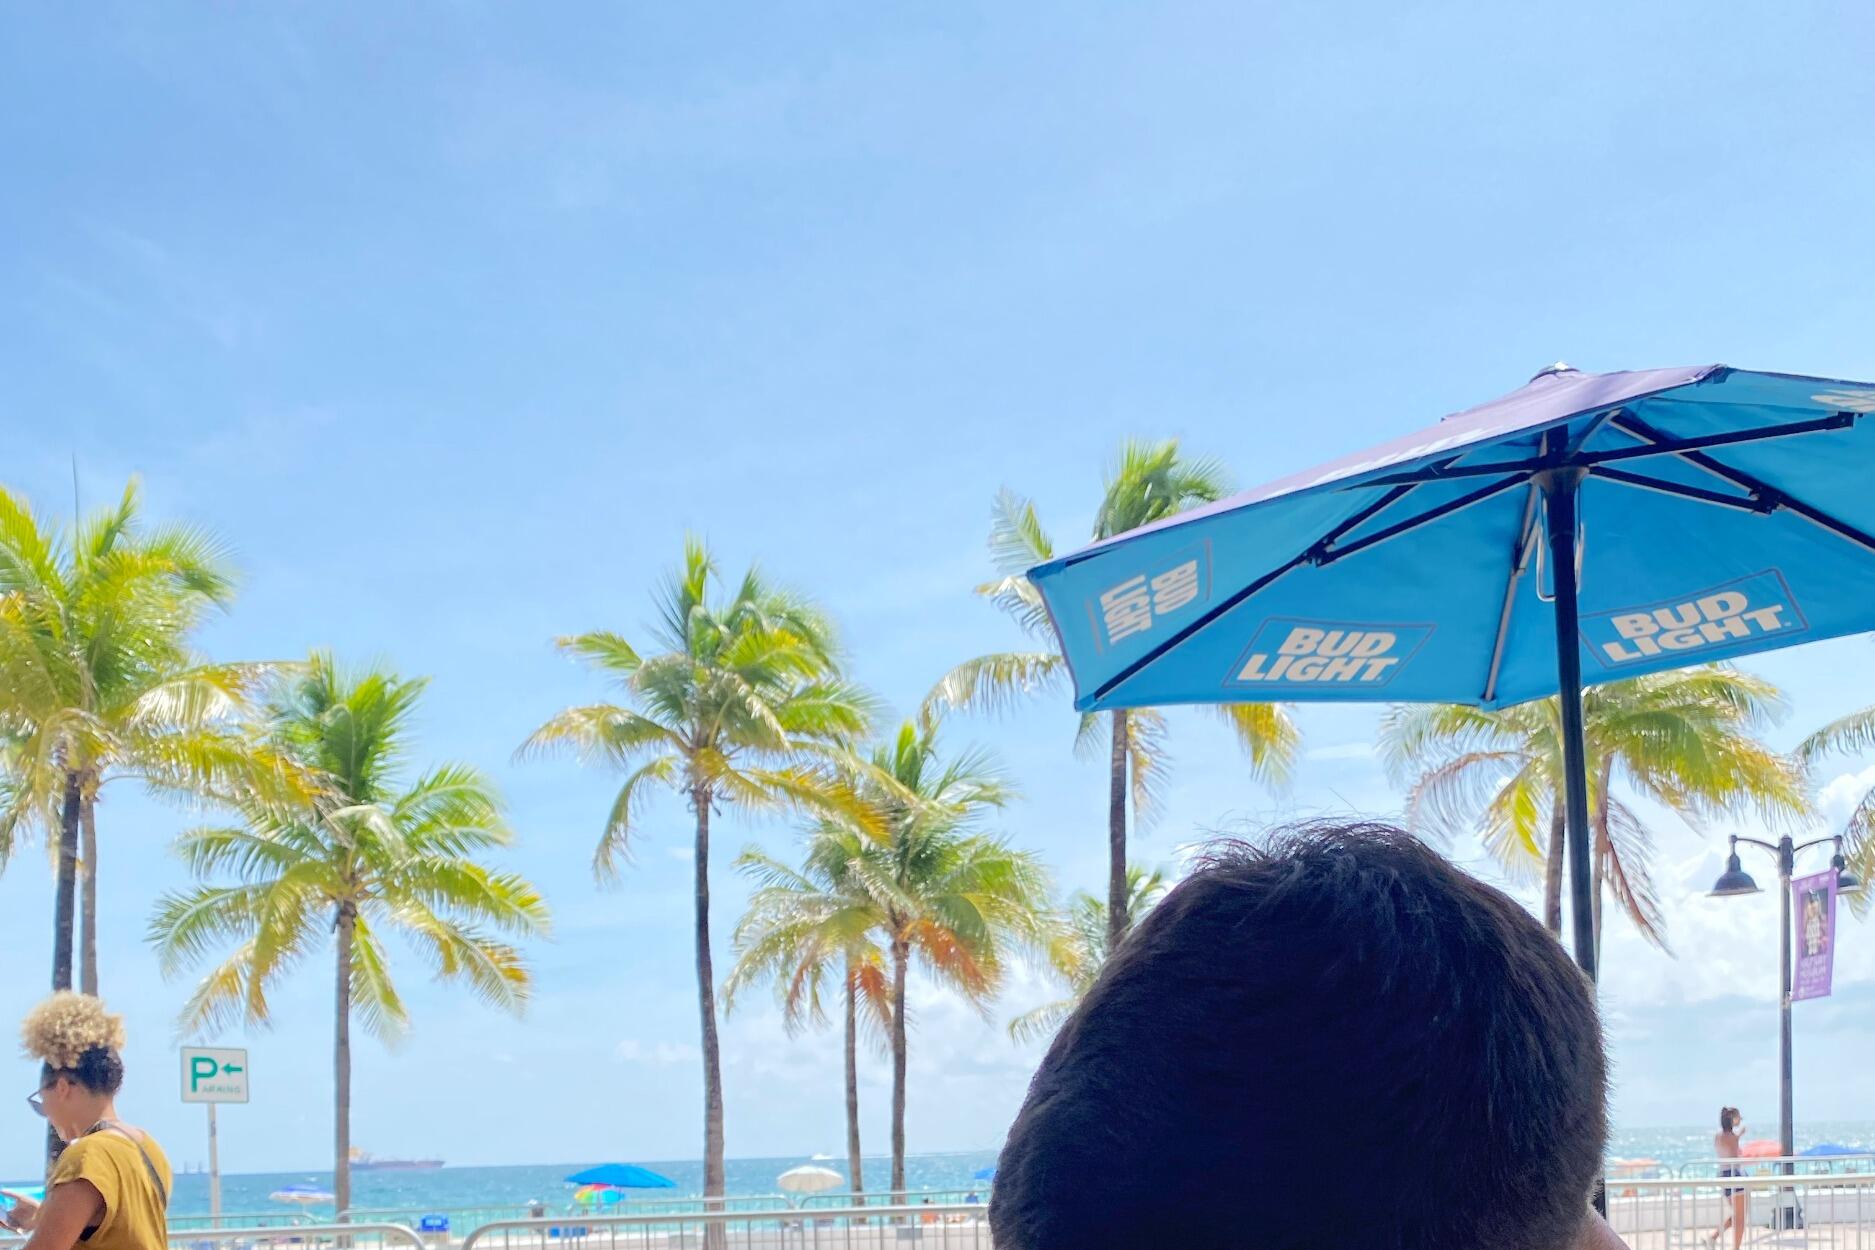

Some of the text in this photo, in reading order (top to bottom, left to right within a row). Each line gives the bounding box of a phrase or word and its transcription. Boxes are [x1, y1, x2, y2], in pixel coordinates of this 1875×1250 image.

[1100, 574, 1152, 646] LIGHT
[1151, 559, 1198, 615] BUD
[1602, 604, 1783, 662] LIGHT
[1610, 591, 1748, 639] BUD
[1237, 654, 1399, 682] LIGHT
[1277, 627, 1397, 657] BUD
